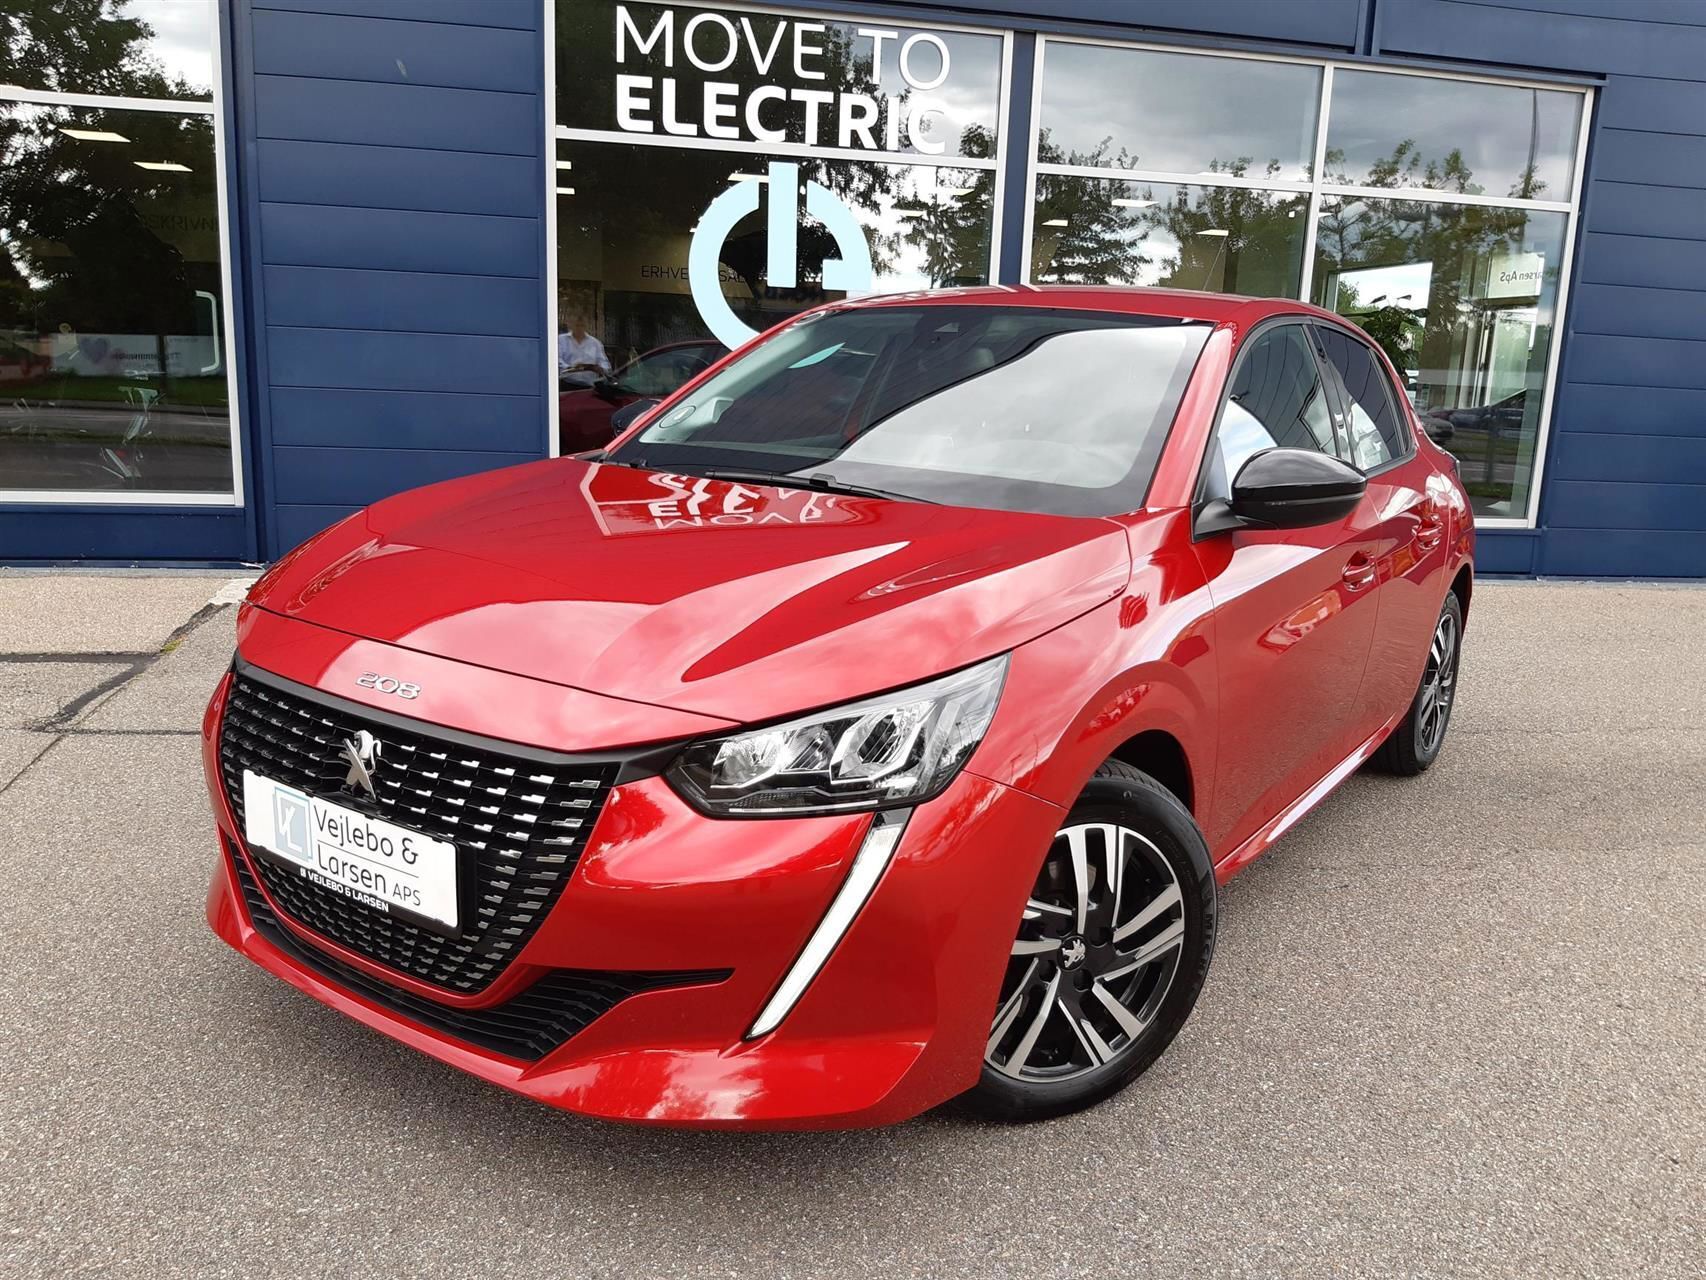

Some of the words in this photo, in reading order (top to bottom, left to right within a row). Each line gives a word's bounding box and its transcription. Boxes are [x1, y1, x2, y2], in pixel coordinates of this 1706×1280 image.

[616, 5, 825, 80] MOVE
[858, 28, 950, 91] TO
[616, 73, 946, 154] ELECTRIC
[355, 671, 421, 700] 208
[314, 804, 394, 857] Vejlebo
[401, 837, 419, 865] &
[307, 870, 343, 894] VEJLEBO
[344, 887, 352, 897] &
[352, 889, 389, 913] LARSEN
[318, 843, 387, 894] Larsen
[393, 882, 421, 906] APS
